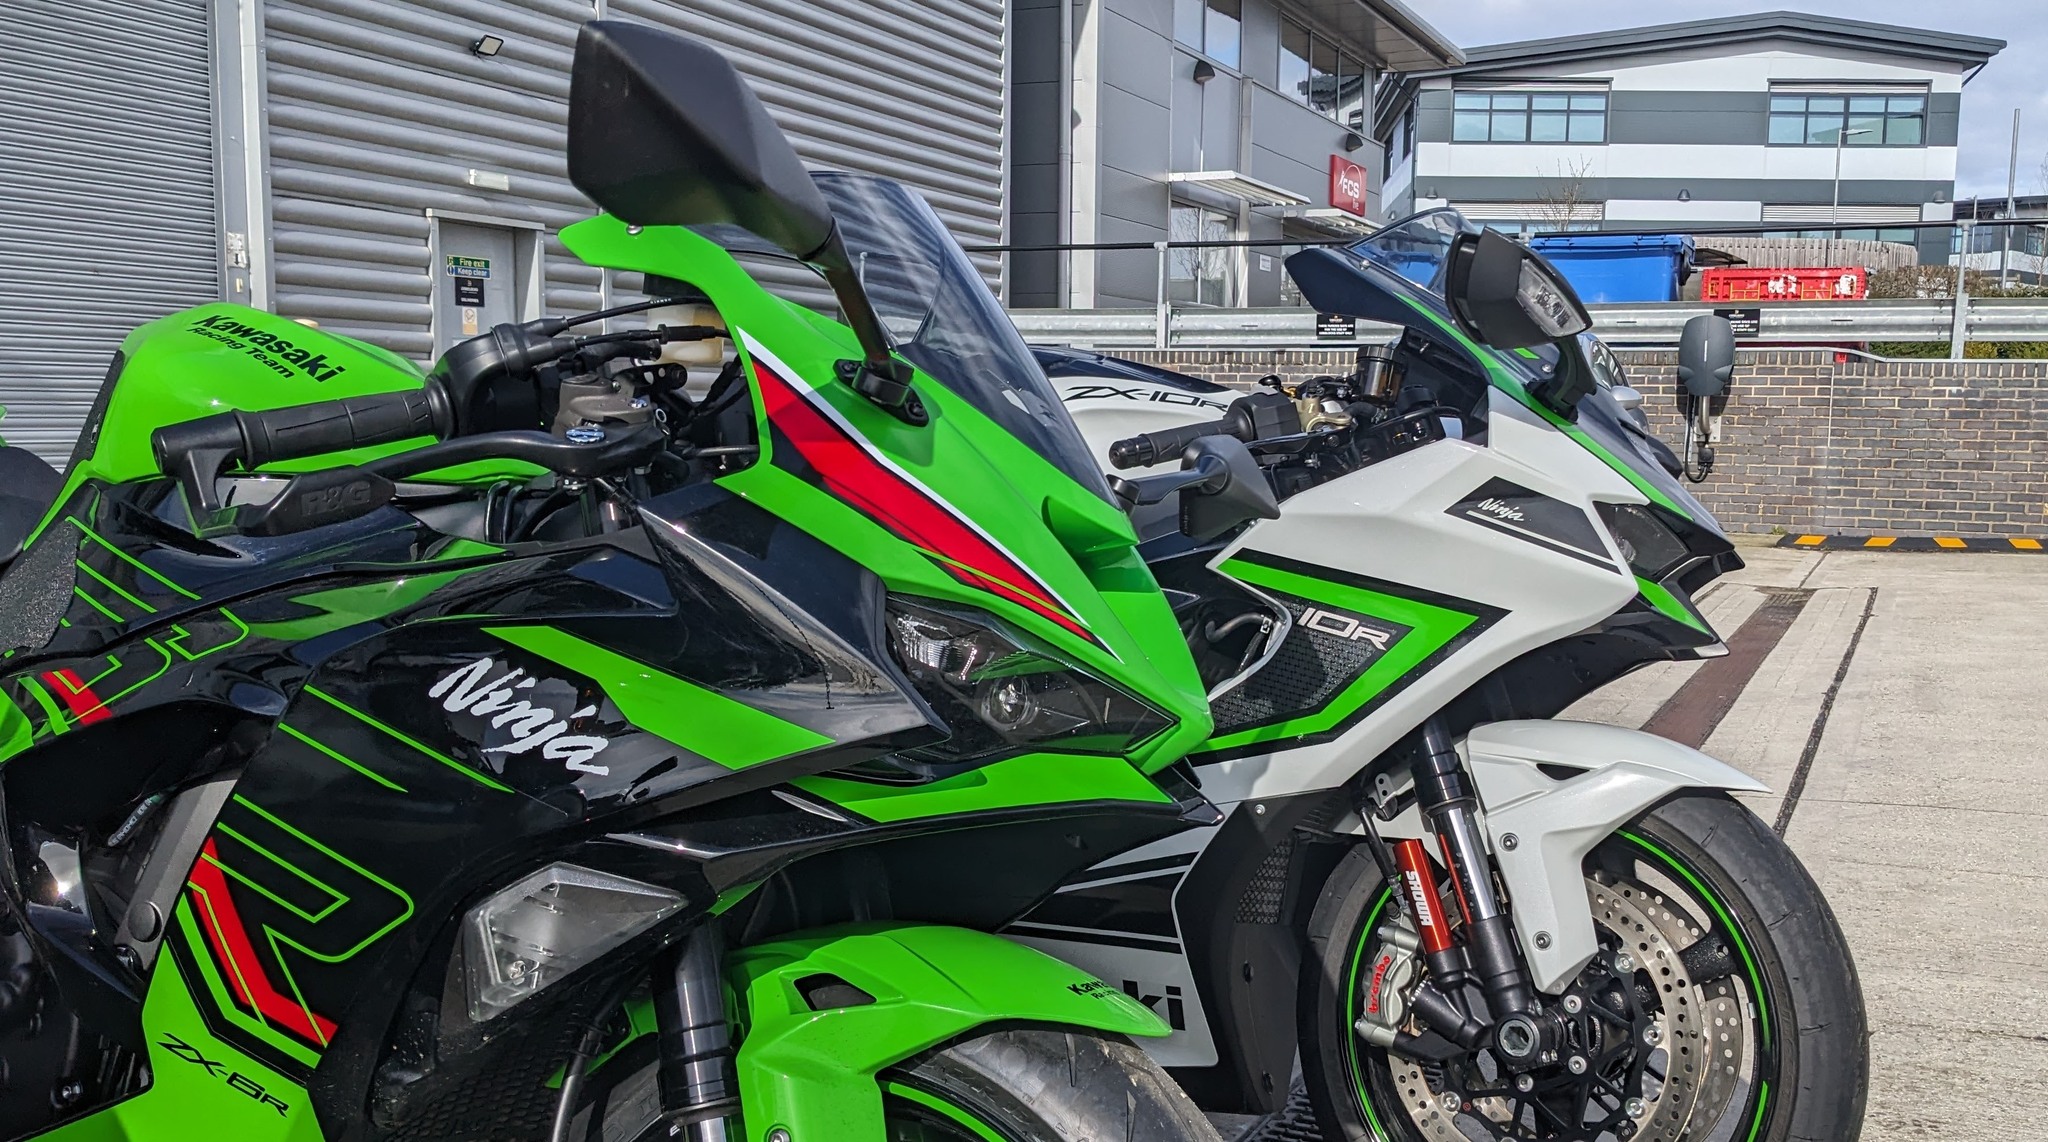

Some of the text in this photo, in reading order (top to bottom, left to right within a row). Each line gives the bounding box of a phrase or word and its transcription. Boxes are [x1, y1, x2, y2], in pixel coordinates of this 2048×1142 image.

[1342, 177, 1360, 199] FCS
[457, 267, 487, 277] Keep clear
[459, 258, 485, 268] Fire exit
[186, 326, 295, 379] Racing Team
[191, 314, 347, 383] Kawasaki
[1062, 385, 1229, 413] ZX-10R
[301, 480, 371, 516] R&G
[1477, 497, 1525, 522] Ninja
[428, 656, 610, 777] Ninja
[1405, 870, 1434, 927] SHOWA
[1368, 955, 1391, 1014] brembo
[155, 1032, 290, 1118] ZX-6R
